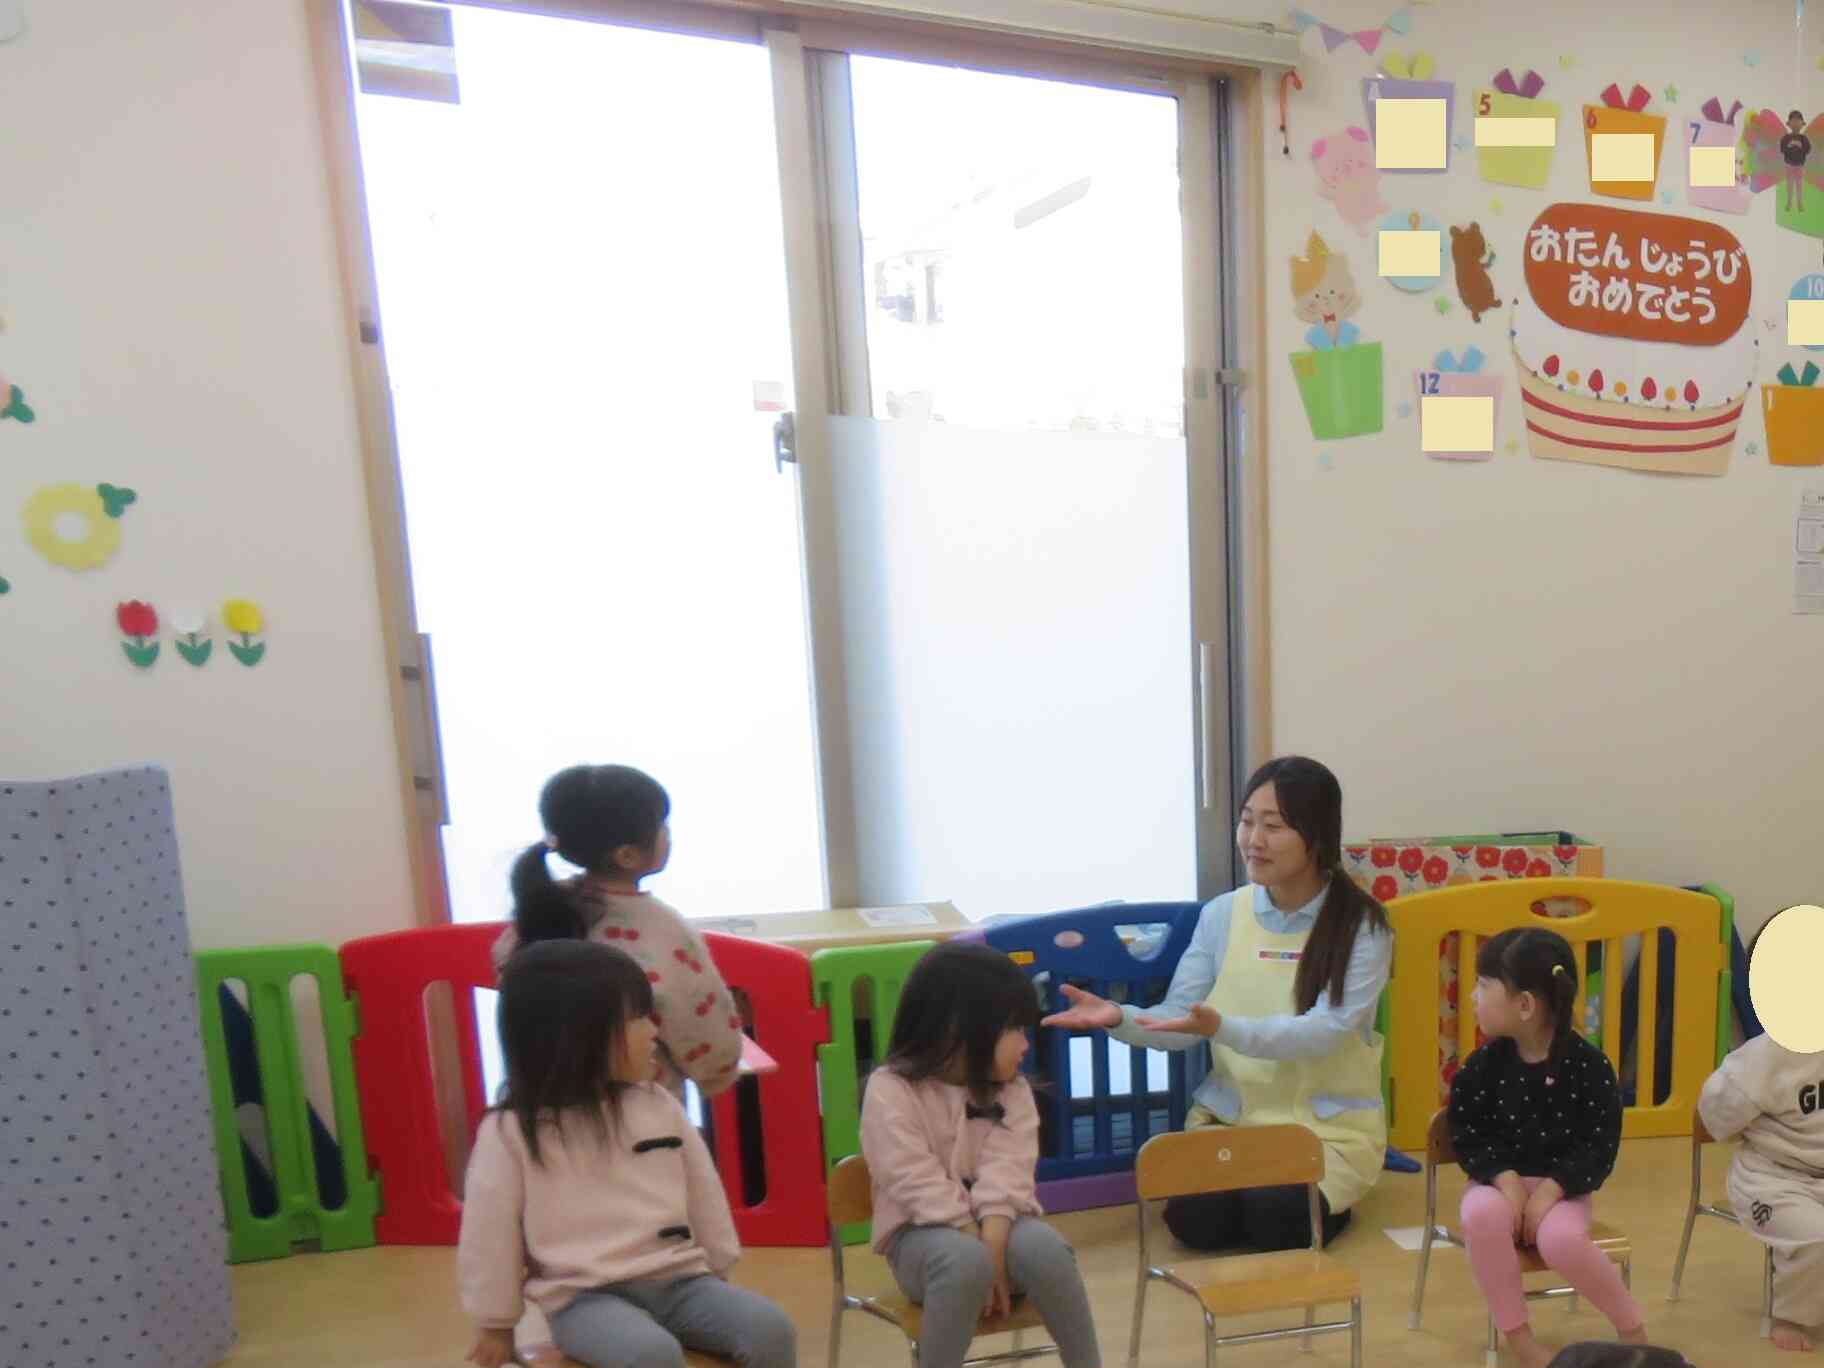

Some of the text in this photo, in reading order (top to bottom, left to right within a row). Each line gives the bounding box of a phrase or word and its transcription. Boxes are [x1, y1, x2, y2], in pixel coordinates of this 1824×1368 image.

[1479, 93, 1491, 115] 5
[1690, 122, 1701, 143] 7
[1568, 270, 1716, 325] おめでとう
[1807, 278, 1824, 298] 10
[1420, 372, 1440, 394] 12
